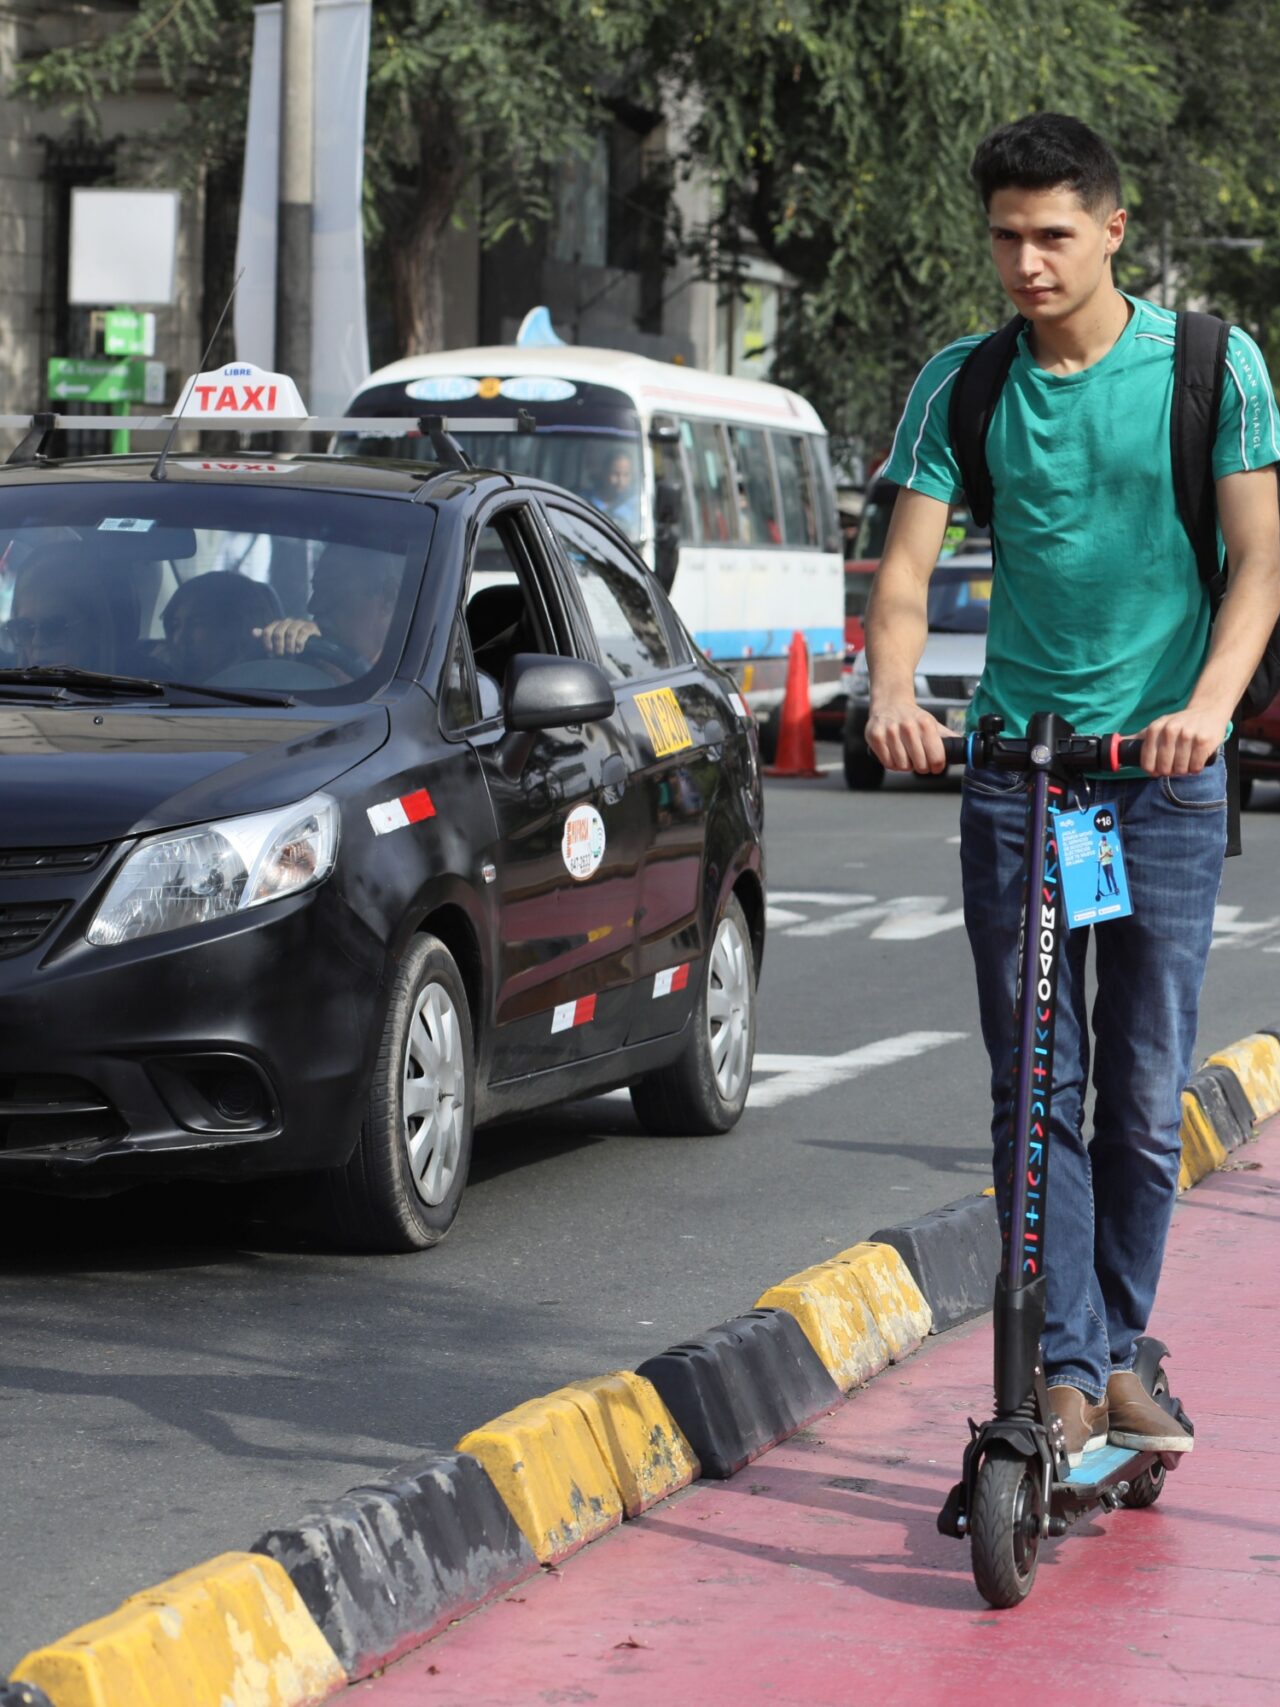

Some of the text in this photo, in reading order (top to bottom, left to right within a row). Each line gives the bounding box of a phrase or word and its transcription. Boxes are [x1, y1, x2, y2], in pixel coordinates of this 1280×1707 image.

[223, 368, 252, 376] LIBRE
[194, 385, 278, 412] TAXI
[1095, 815, 1112, 827] +18
[1037, 903, 1055, 1001] MOVO
